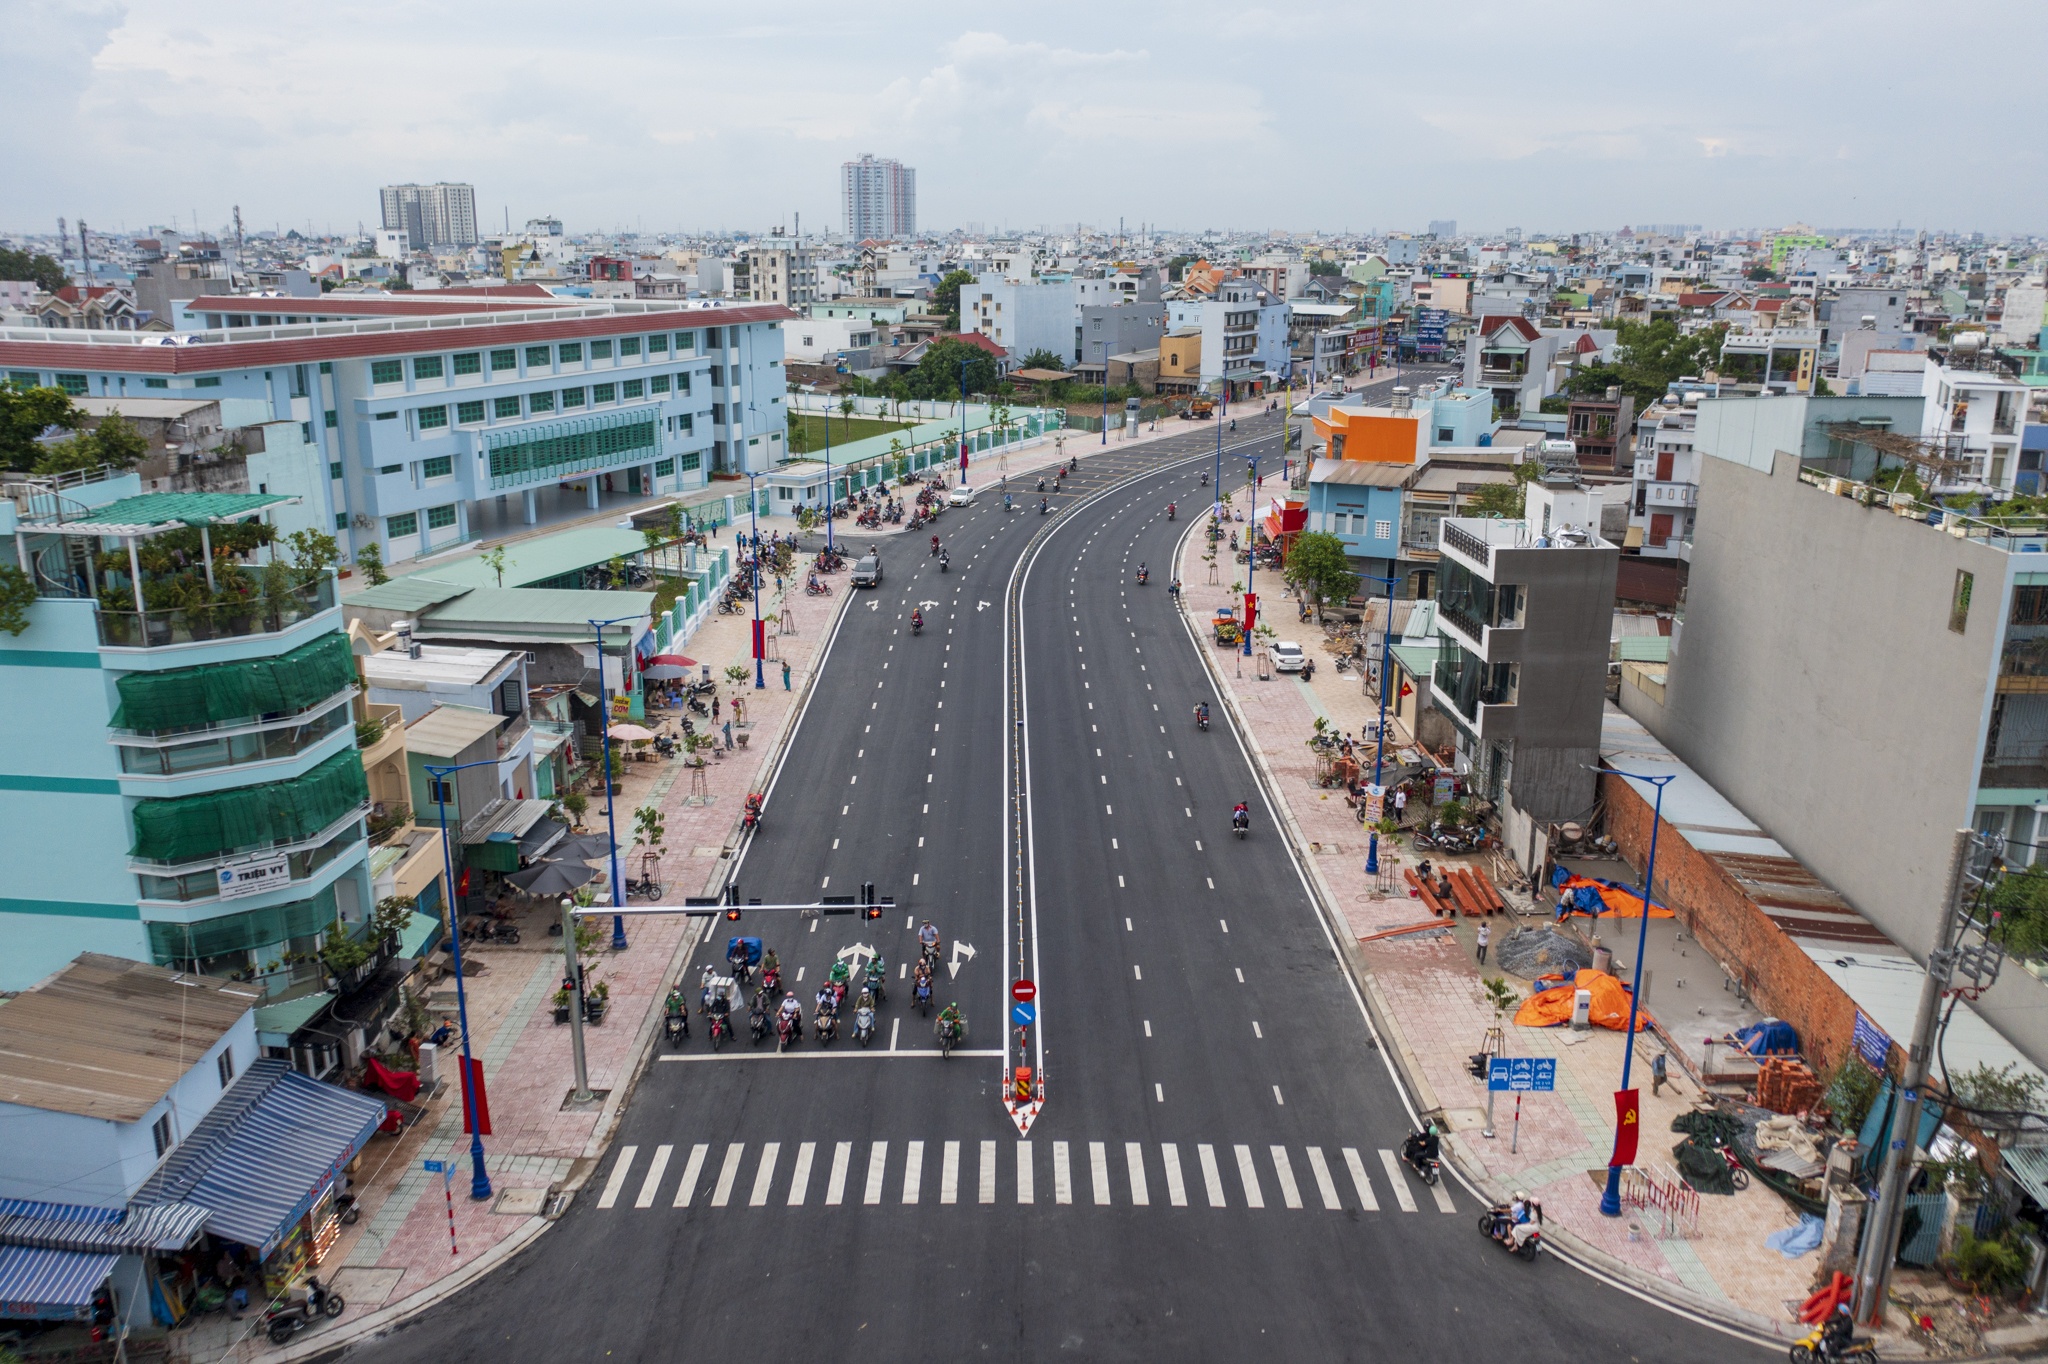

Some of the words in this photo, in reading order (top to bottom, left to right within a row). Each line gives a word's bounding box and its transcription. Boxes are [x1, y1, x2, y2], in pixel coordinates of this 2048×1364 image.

[237, 868, 267, 881] TRIỆU
[269, 865, 284, 875] VY
[310, 1169, 333, 1199] KIM
[334, 1143, 355, 1170] CHI
